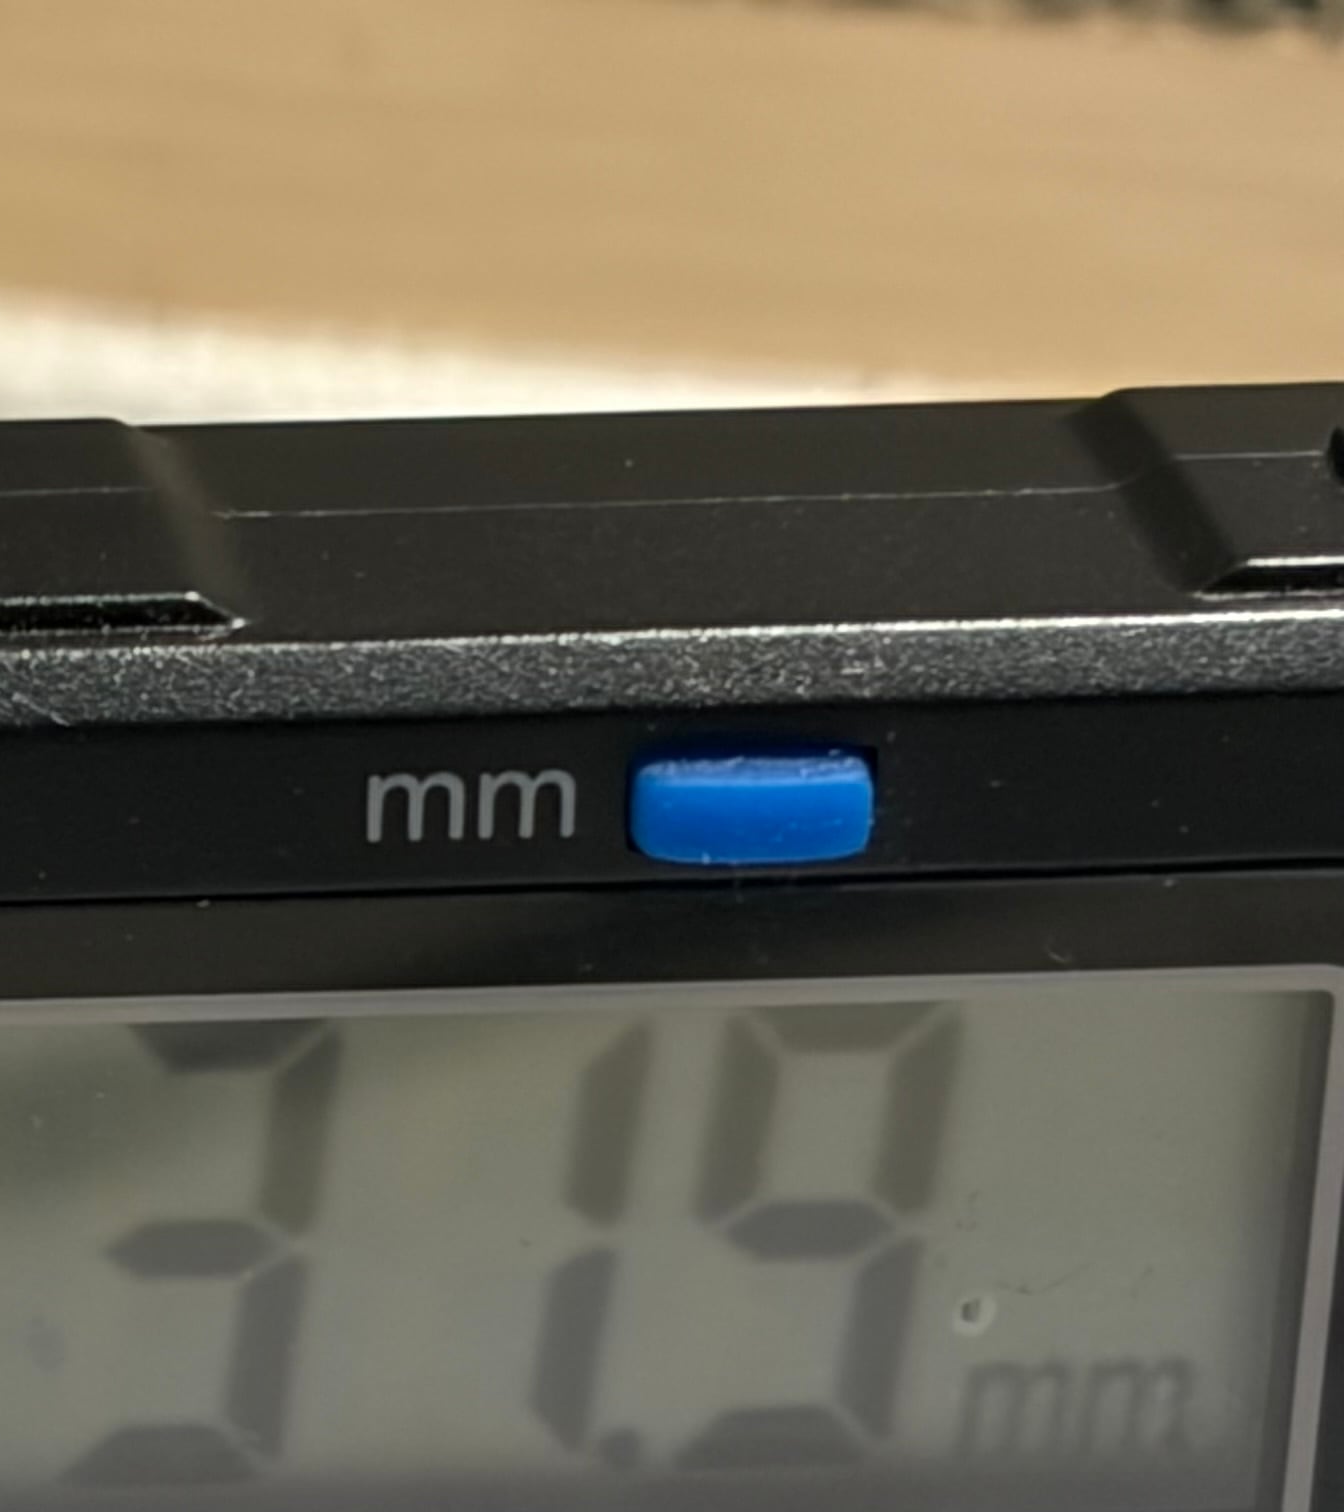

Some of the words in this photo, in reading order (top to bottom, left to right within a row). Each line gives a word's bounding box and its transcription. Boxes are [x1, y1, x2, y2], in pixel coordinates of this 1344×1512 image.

[366, 768, 576, 843] mm
[54, 1000, 964, 1487] 31.9
[952, 1353, 1198, 1458] mm
